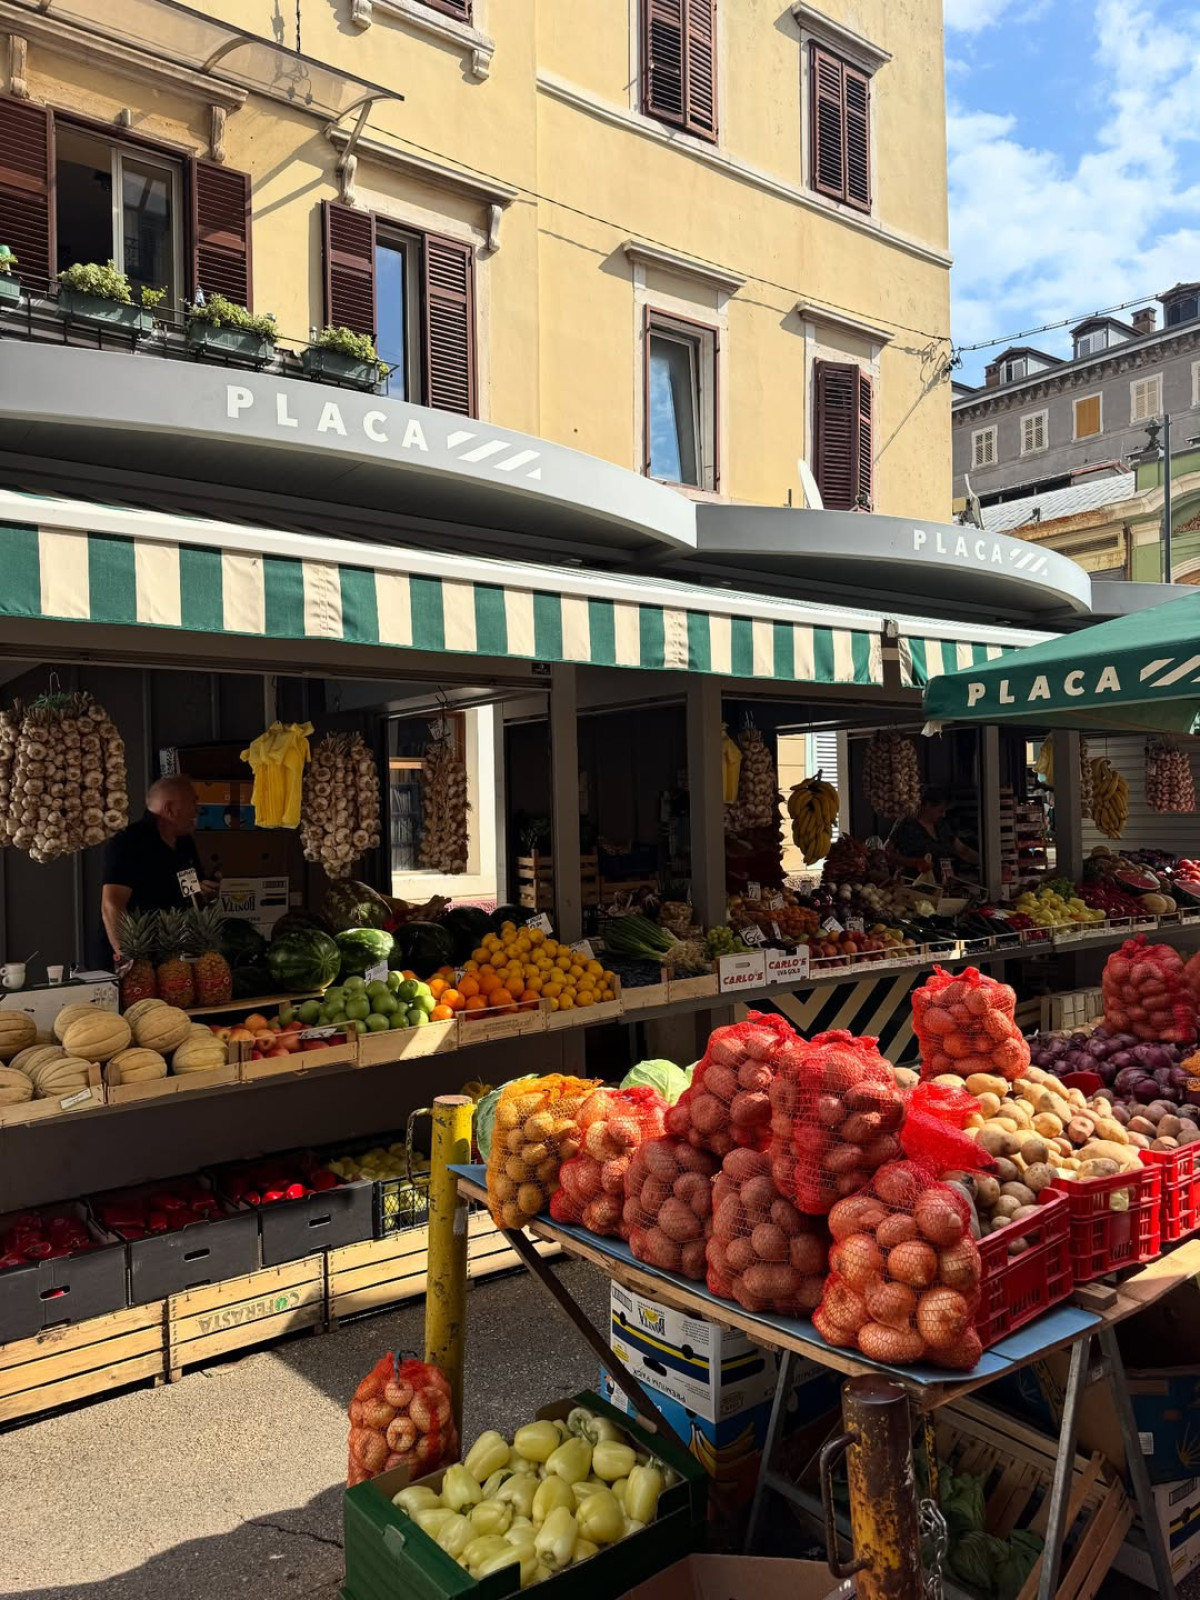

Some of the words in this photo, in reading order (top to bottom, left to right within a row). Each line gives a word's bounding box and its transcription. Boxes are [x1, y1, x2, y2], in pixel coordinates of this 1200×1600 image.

[226, 385, 429, 451] PLACA
[913, 529, 1004, 564] PLACA
[967, 666, 1121, 707] PLACA
[768, 957, 807, 970] CARLO'S
[723, 972, 763, 985] CARLO'S
[638, 1307, 665, 1336] BONITA
[651, 1378, 686, 1404] PREMIUM
